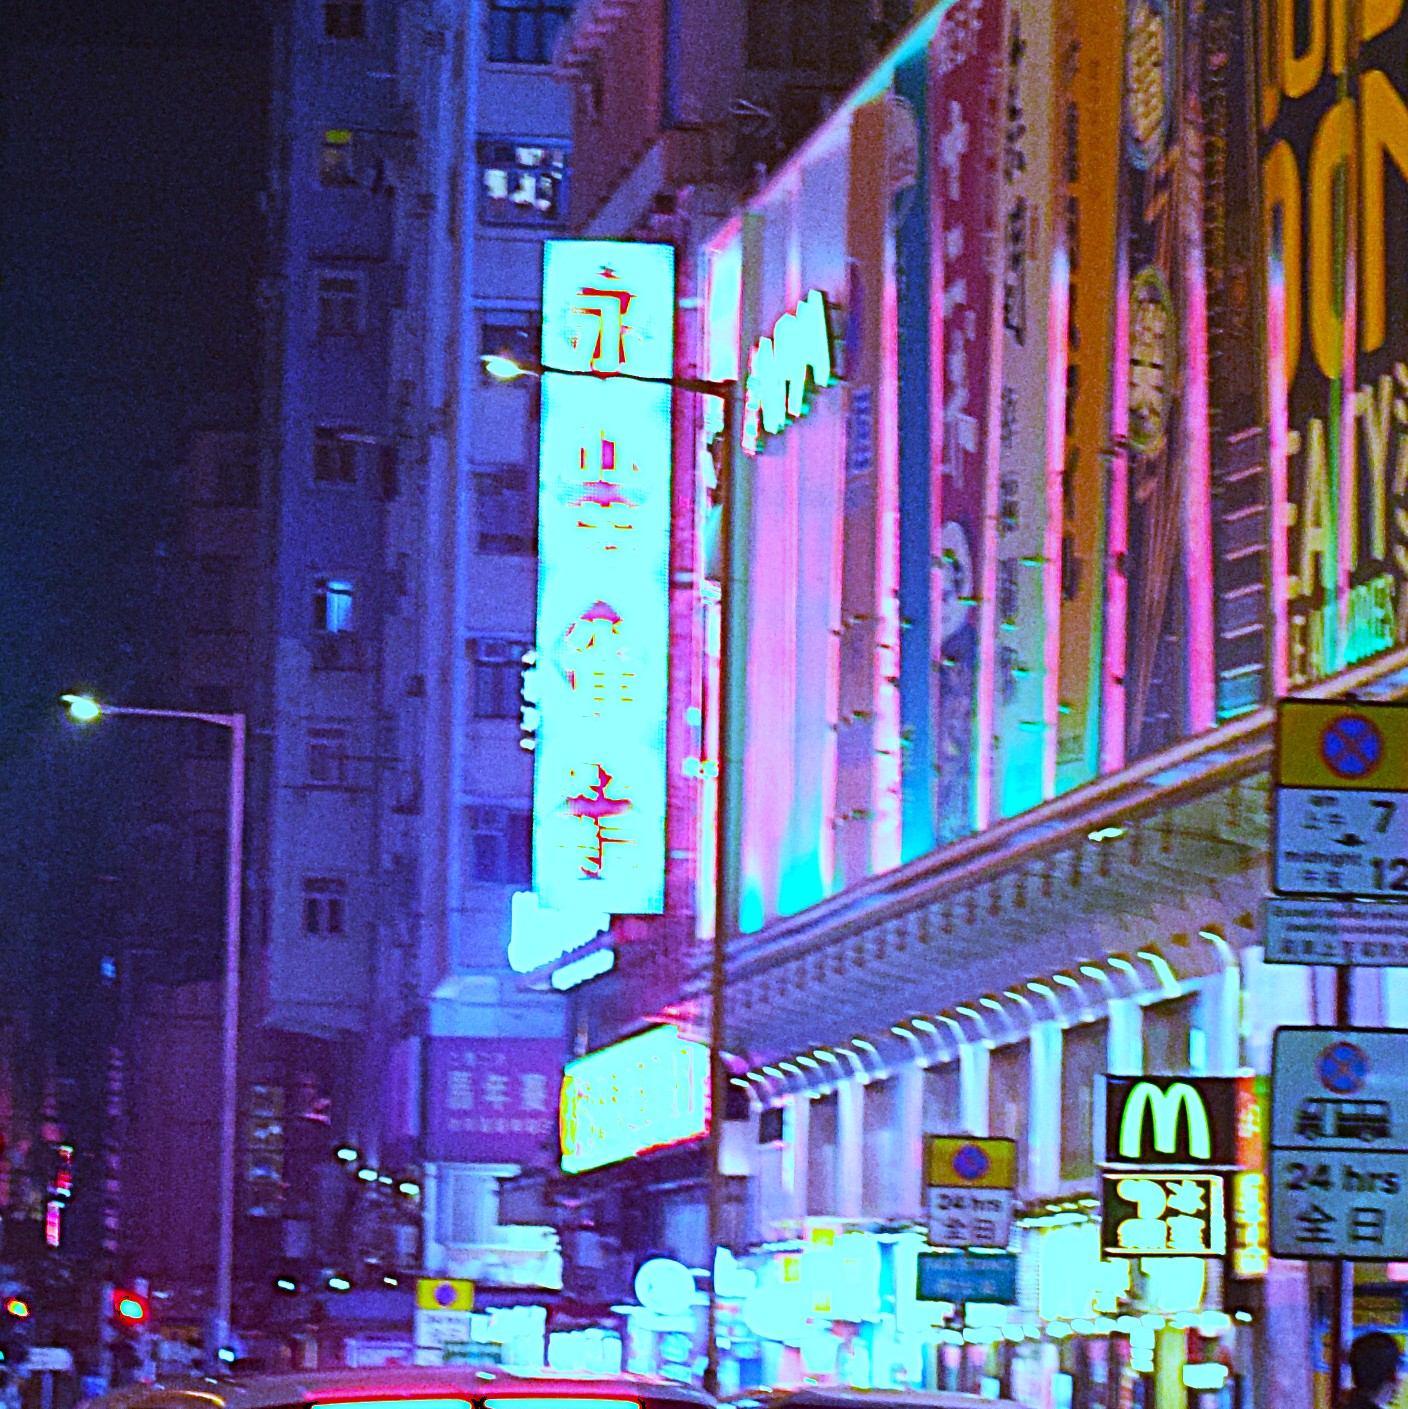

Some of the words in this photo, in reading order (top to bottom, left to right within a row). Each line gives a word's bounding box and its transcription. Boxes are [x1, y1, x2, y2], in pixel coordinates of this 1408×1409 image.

[1368, 800, 1397, 834] 7
[1284, 1162, 1332, 1191] 24
[1342, 1164, 1399, 1194] hrs
[1294, 1203, 1385, 1245] 全日
